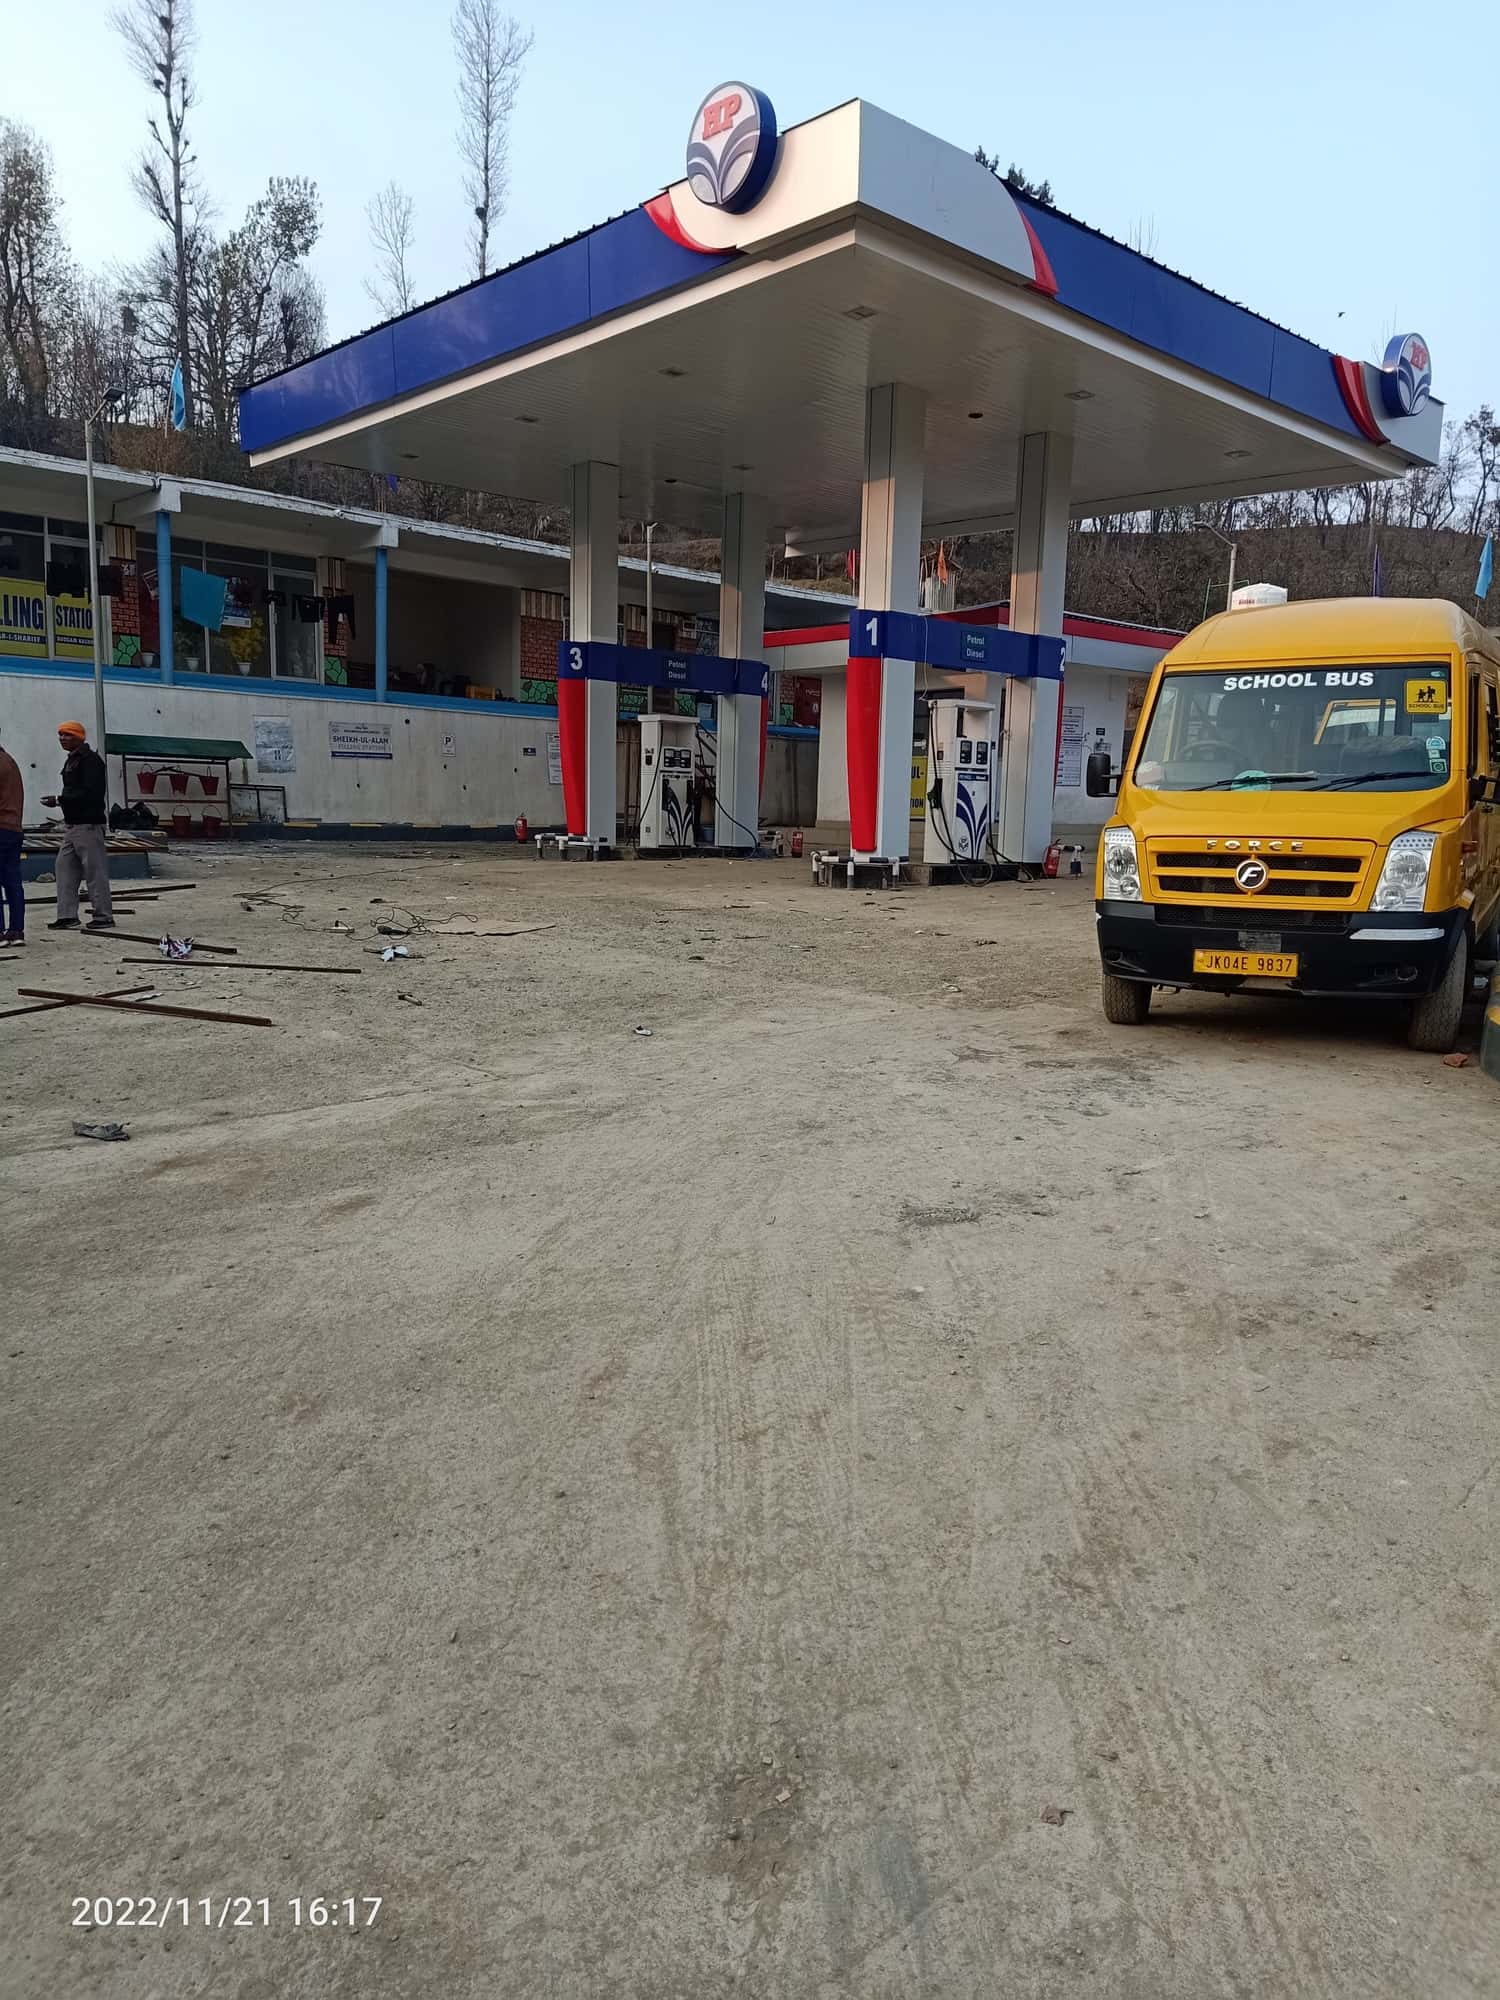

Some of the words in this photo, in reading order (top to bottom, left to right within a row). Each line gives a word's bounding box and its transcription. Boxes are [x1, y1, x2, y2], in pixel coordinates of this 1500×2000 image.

[703, 94, 742, 140] HP
[0, 594, 44, 630] LING
[55, 605, 94, 630] STATIO
[865, 617, 879, 646] 1
[966, 634, 985, 646] Petrol
[569, 647, 583, 670] 3
[966, 648, 985, 659] Diesel
[1059, 647, 1066, 672] 2
[668, 659, 687, 669] Petrol
[668, 671, 687, 680] Diesel
[761, 671, 769, 692] 4
[1223, 673, 1318, 691] SCHOOL
[1324, 672, 1375, 686] BUS
[444, 736, 452, 745] P
[1206, 840, 1304, 851] FORCE
[1206, 956, 1249, 970] JK04E
[1257, 958, 1294, 972] 9837
